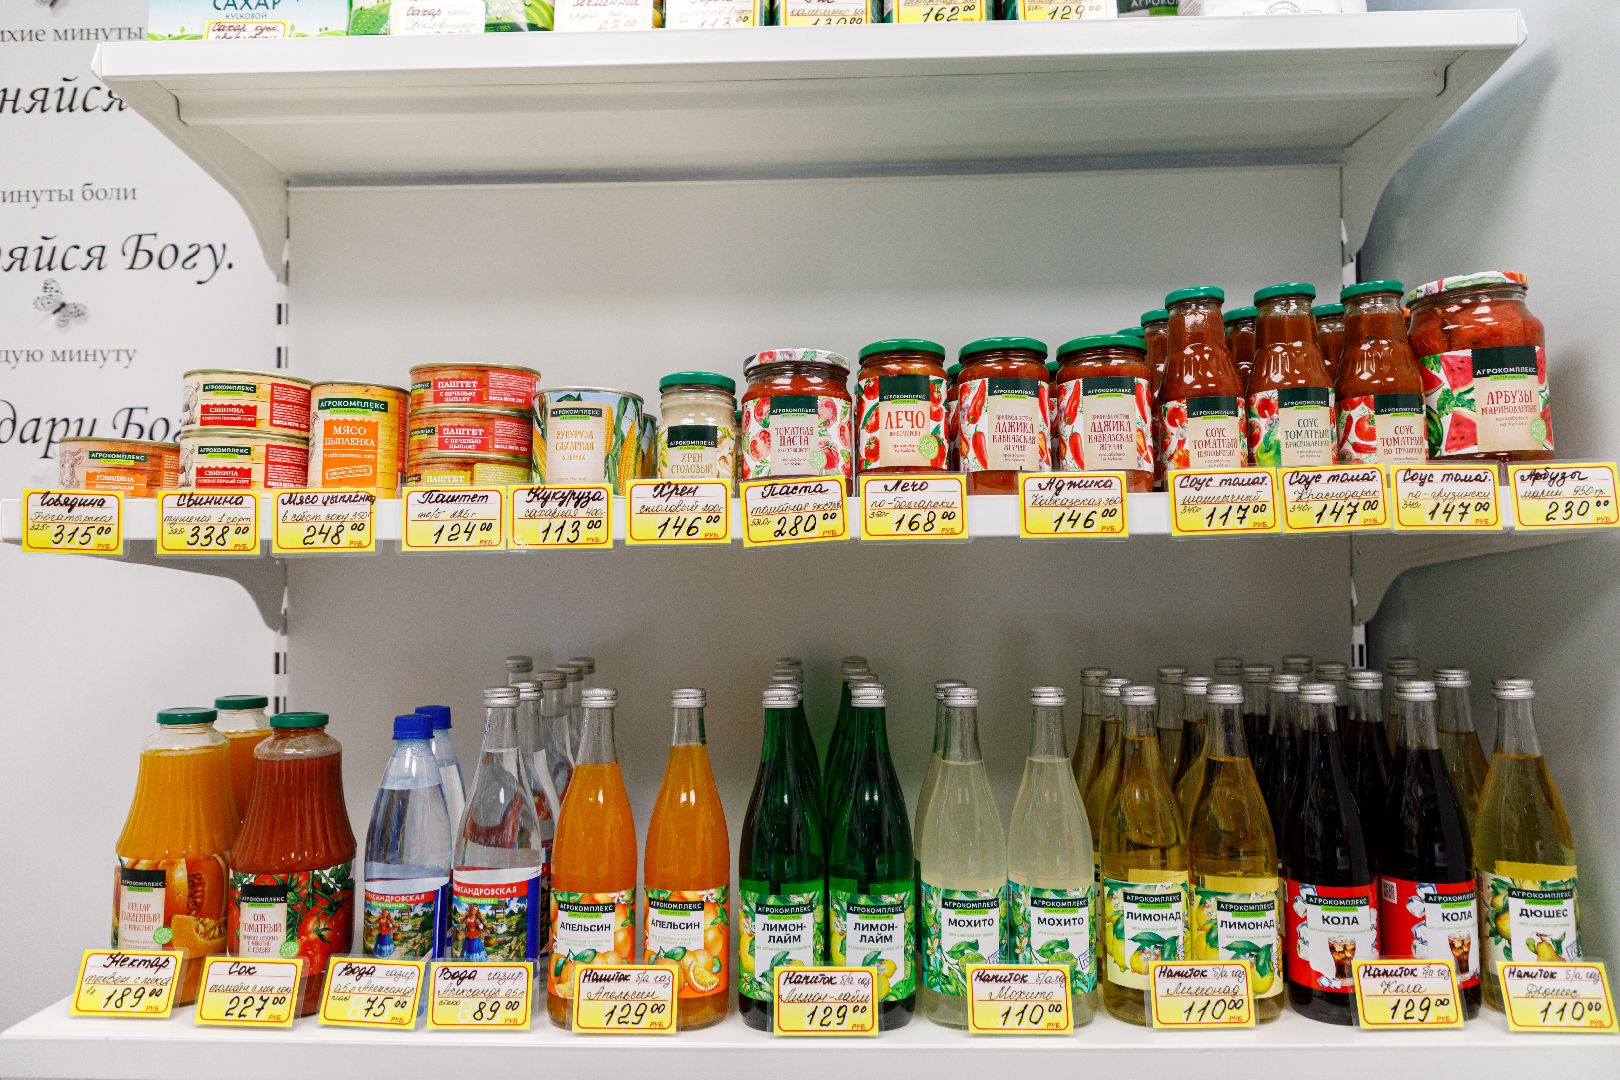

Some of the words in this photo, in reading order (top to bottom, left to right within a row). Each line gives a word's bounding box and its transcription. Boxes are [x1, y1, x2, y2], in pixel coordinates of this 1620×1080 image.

[406, 6, 442, 17] Сахар
[923, 6, 959, 22] 162
[1048, 5, 1085, 19] 129
[53, 27, 144, 42] минуты
[81, 183, 137, 201] боли
[0, 234, 108, 272] яйся
[121, 232, 233, 285] Богу.
[51, 349, 137, 369] минуту
[1476, 367, 1537, 375] АГРОКОМПЛЕКС
[438, 380, 478, 388] ПАШТЕТ
[1486, 390, 1533, 405] АРБУЗЫ
[320, 400, 385, 410] АГРОКОМПЛЕКС
[551, 408, 600, 416] АГРОКОМПЛЕКС
[885, 411, 926, 429] ЛЕЧО
[1297, 418, 1318, 428] СОУС
[333, 425, 367, 436] МЯСО
[442, 428, 484, 436] ПАШТЕТ
[994, 422, 1035, 434] АДЖИКА
[1090, 421, 1132, 433] АДЖИКА
[1206, 428, 1226, 438] СОУС
[1394, 425, 1414, 435] СОУС
[992, 433, 1036, 445] КАВКАЗСКАЯ
[1088, 433, 1133, 443] КАВКАЗСКАЯ
[1284, 428, 1329, 440] ТОМАТНЫЙ
[779, 436, 809, 447] ПАСТА
[1191, 438, 1238, 449] ТОМАТНЫЙ
[1379, 436, 1424, 447] ТОМАТНЫЙ
[91, 452, 145, 461] АГРОКОМПЛЕКС
[681, 453, 703, 462] ХРЕН
[670, 463, 714, 475] СТОЛОВЫЙ
[427, 475, 465, 483] ПАШТЕТ
[1180, 475, 1213, 491] Соус
[1289, 471, 1322, 490] Соус
[1403, 468, 1434, 486] Соус
[1520, 467, 1588, 487] Арбузы
[653, 481, 699, 502] Хрен
[761, 483, 829, 499] Паста
[884, 480, 929, 492] Лечо
[1038, 477, 1113, 496] Аджика
[40, 491, 106, 513] Говядина
[176, 492, 244, 507] Свинина
[281, 493, 318, 505] Мясо
[417, 490, 489, 504] Паштет
[526, 486, 604, 508] Кукуруза
[1206, 504, 1250, 527] 117
[1316, 502, 1359, 524] 147
[1428, 502, 1471, 522] 147
[1546, 501, 1590, 521] 230
[658, 516, 701, 538] 146
[774, 514, 817, 537] 280
[895, 511, 936, 532] 168
[1053, 510, 1097, 532] 146
[52, 525, 95, 545] 315
[187, 526, 230, 547] 338
[303, 524, 345, 545] 248
[434, 522, 477, 544] 124
[542, 520, 581, 543] 113
[1126, 894, 1180, 903] АГРОКОМПЛЕКС
[1428, 893, 1476, 902] АГРОКОМПЛЕКС
[1511, 890, 1572, 899] АГРОКОМПЛЕКС
[559, 903, 613, 912] АГРОКОМПЛЕКС
[650, 900, 702, 910] АГРОКОМПЛЕКС
[944, 900, 998, 908] АГРОКОМПЛЕКС
[1033, 900, 1087, 908] АГРОКОМПЛЕКС
[1220, 902, 1274, 911] АГРОКОМПЛЕКС
[1309, 897, 1367, 906] АГРОКОМПЛЕКС
[758, 905, 811, 914] АГРОКОМПЛЕКС
[850, 905, 902, 914] АГРОКОМПЛЕКС
[1519, 908, 1568, 918] ДЮШЕС
[253, 913, 265, 921] СОК
[948, 918, 994, 928] МОХИТО
[1038, 917, 1084, 927] МОХИТО
[1126, 911, 1181, 922] ЛИМОНАД
[1322, 915, 1360, 926] КОЛА
[1442, 911, 1473, 922] КОЛА
[560, 922, 611, 932] АПЕЛЬСИН
[651, 918, 700, 930] АПЕЛЬСИН
[762, 922, 807, 932] ЛИМОН-
[853, 922, 898, 932] ЛИМОН-
[1220, 919, 1275, 930] ЛИМОНАД
[768, 933, 801, 944] ЛАЙМ
[859, 933, 892, 944] ЛАЙМ
[103, 952, 170, 974] Нектар
[228, 962, 257, 975] Сок
[338, 963, 376, 981] Вода
[439, 967, 478, 986] Вода
[582, 969, 631, 983] Напиток
[783, 971, 837, 985] Напиток
[975, 970, 1029, 983] Напиток
[1159, 966, 1208, 978] Напиток
[1363, 965, 1418, 978] Напиток
[1508, 968, 1558, 979] Напиток
[586, 986, 659, 1000] Апельсин
[989, 986, 1054, 1001] Мохито
[1167, 982, 1239, 997] Лимонад
[1380, 980, 1427, 994] Кола
[1526, 984, 1579, 998] Дюшес
[103, 987, 145, 1009] 189
[225, 995, 269, 1018] 227
[364, 997, 393, 1017] 75
[473, 1001, 500, 1021] 89
[1184, 999, 1226, 1022] 110
[1228, 999, 1243, 1010] 00
[1391, 997, 1431, 1022] 129
[1435, 998, 1449, 1007] 00
[1540, 1001, 1584, 1022] 110
[1588, 1002, 1601, 1011] 00
[605, 1003, 647, 1026] 129
[807, 1005, 848, 1027] 129
[1001, 1004, 1044, 1026] 110
[1048, 1004, 1062, 1013] 00
